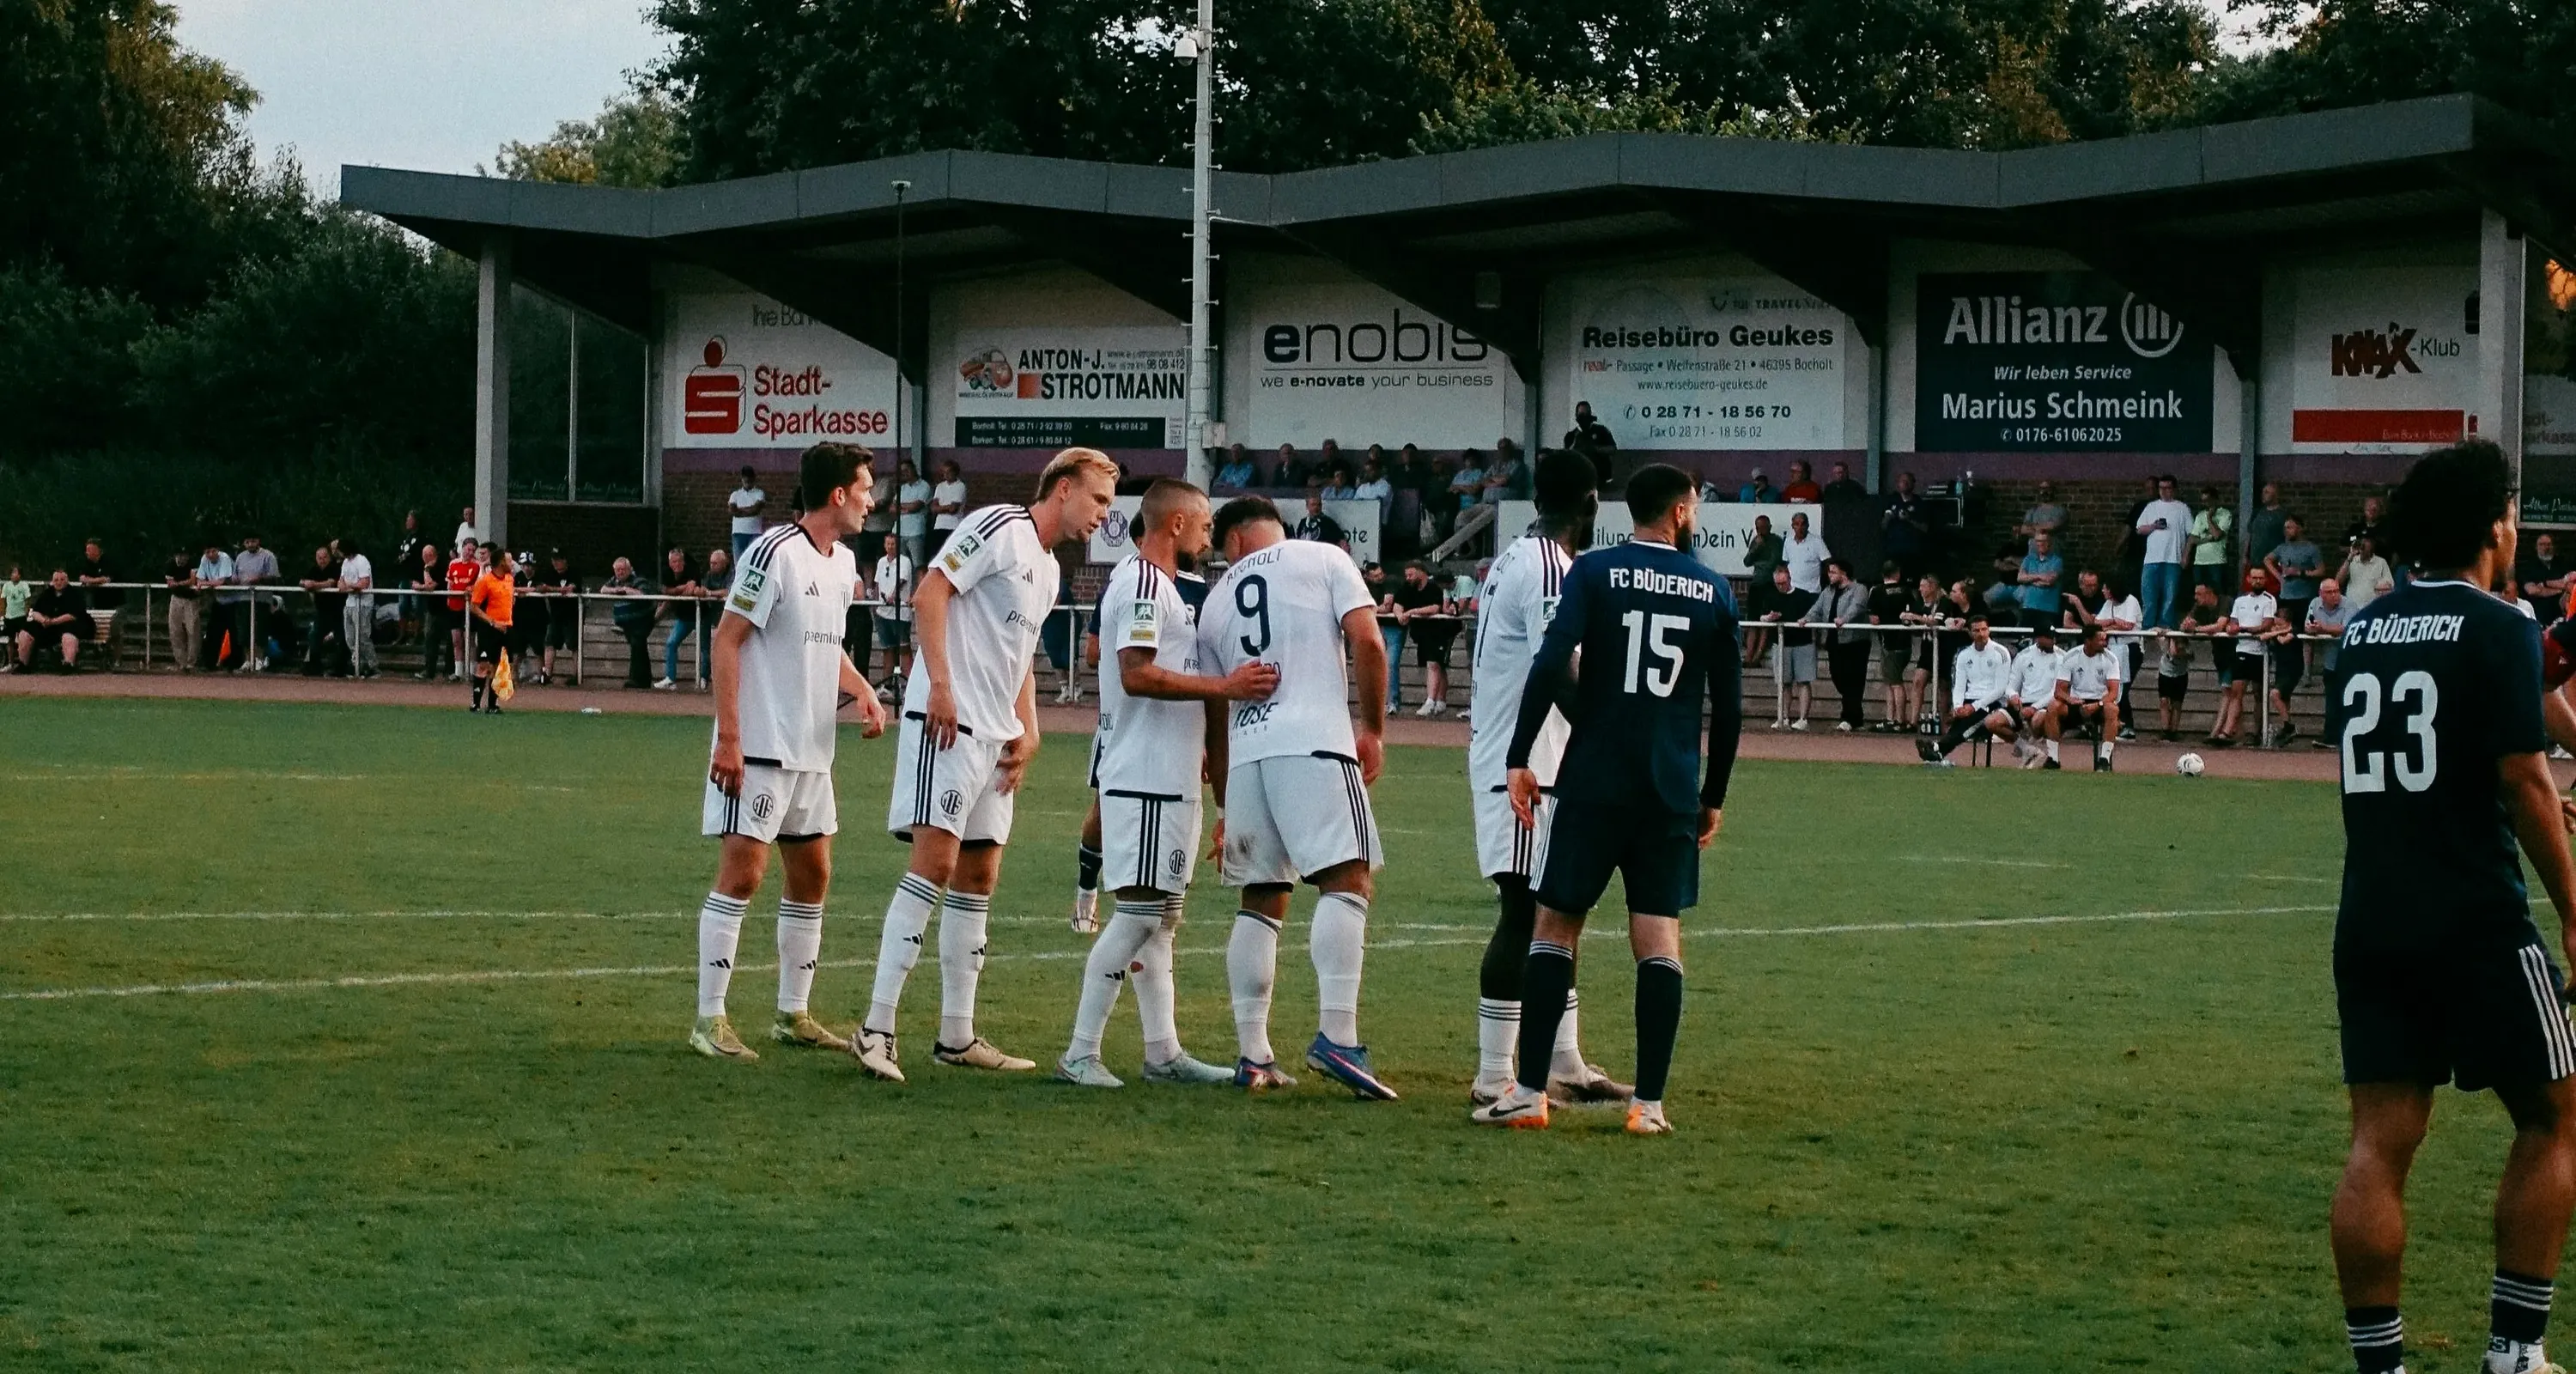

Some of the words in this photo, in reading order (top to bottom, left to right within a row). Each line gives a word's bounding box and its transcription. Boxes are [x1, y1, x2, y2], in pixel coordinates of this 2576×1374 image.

[1944, 295, 2108, 344] Allianz
[1264, 308, 1488, 362] enobis
[1583, 325, 1720, 348] Reisebüro
[1729, 325, 1834, 347] Geukes
[1018, 349, 1105, 370] ANTON-J.
[1617, 359, 1655, 374] Passage
[1735, 359, 1746, 371] 21
[1760, 359, 1791, 371] 46395
[1795, 357, 1834, 372] Bocholt
[1994, 365, 2022, 380] Wir
[2026, 364, 2069, 380] leben
[2074, 364, 2131, 380] Service
[754, 365, 831, 396] Stadt-
[1041, 373, 1184, 399] STROTMANN
[1260, 376, 1284, 387] we
[1371, 376, 1410, 389] your
[1417, 373, 1493, 387] business
[1642, 406, 1651, 418] 0
[1657, 406, 1677, 419] 28
[1683, 406, 1700, 419] 71
[1721, 406, 1739, 418] 18
[1745, 406, 1765, 418] 56
[1771, 406, 1791, 418] 70
[1942, 392, 2036, 419] Marius
[2047, 389, 2184, 419] Schmeink
[754, 404, 889, 440] Sparkasse
[2016, 427, 2122, 442] 0176-61062025
[1610, 568, 1630, 588] FC
[1633, 568, 1714, 604] BÜDERICH
[1235, 574, 1271, 658] 9
[2342, 619, 2367, 649] FC
[2366, 613, 2464, 644] BÜDERICH
[1622, 610, 1690, 697] 15
[2342, 671, 2439, 794] 23
